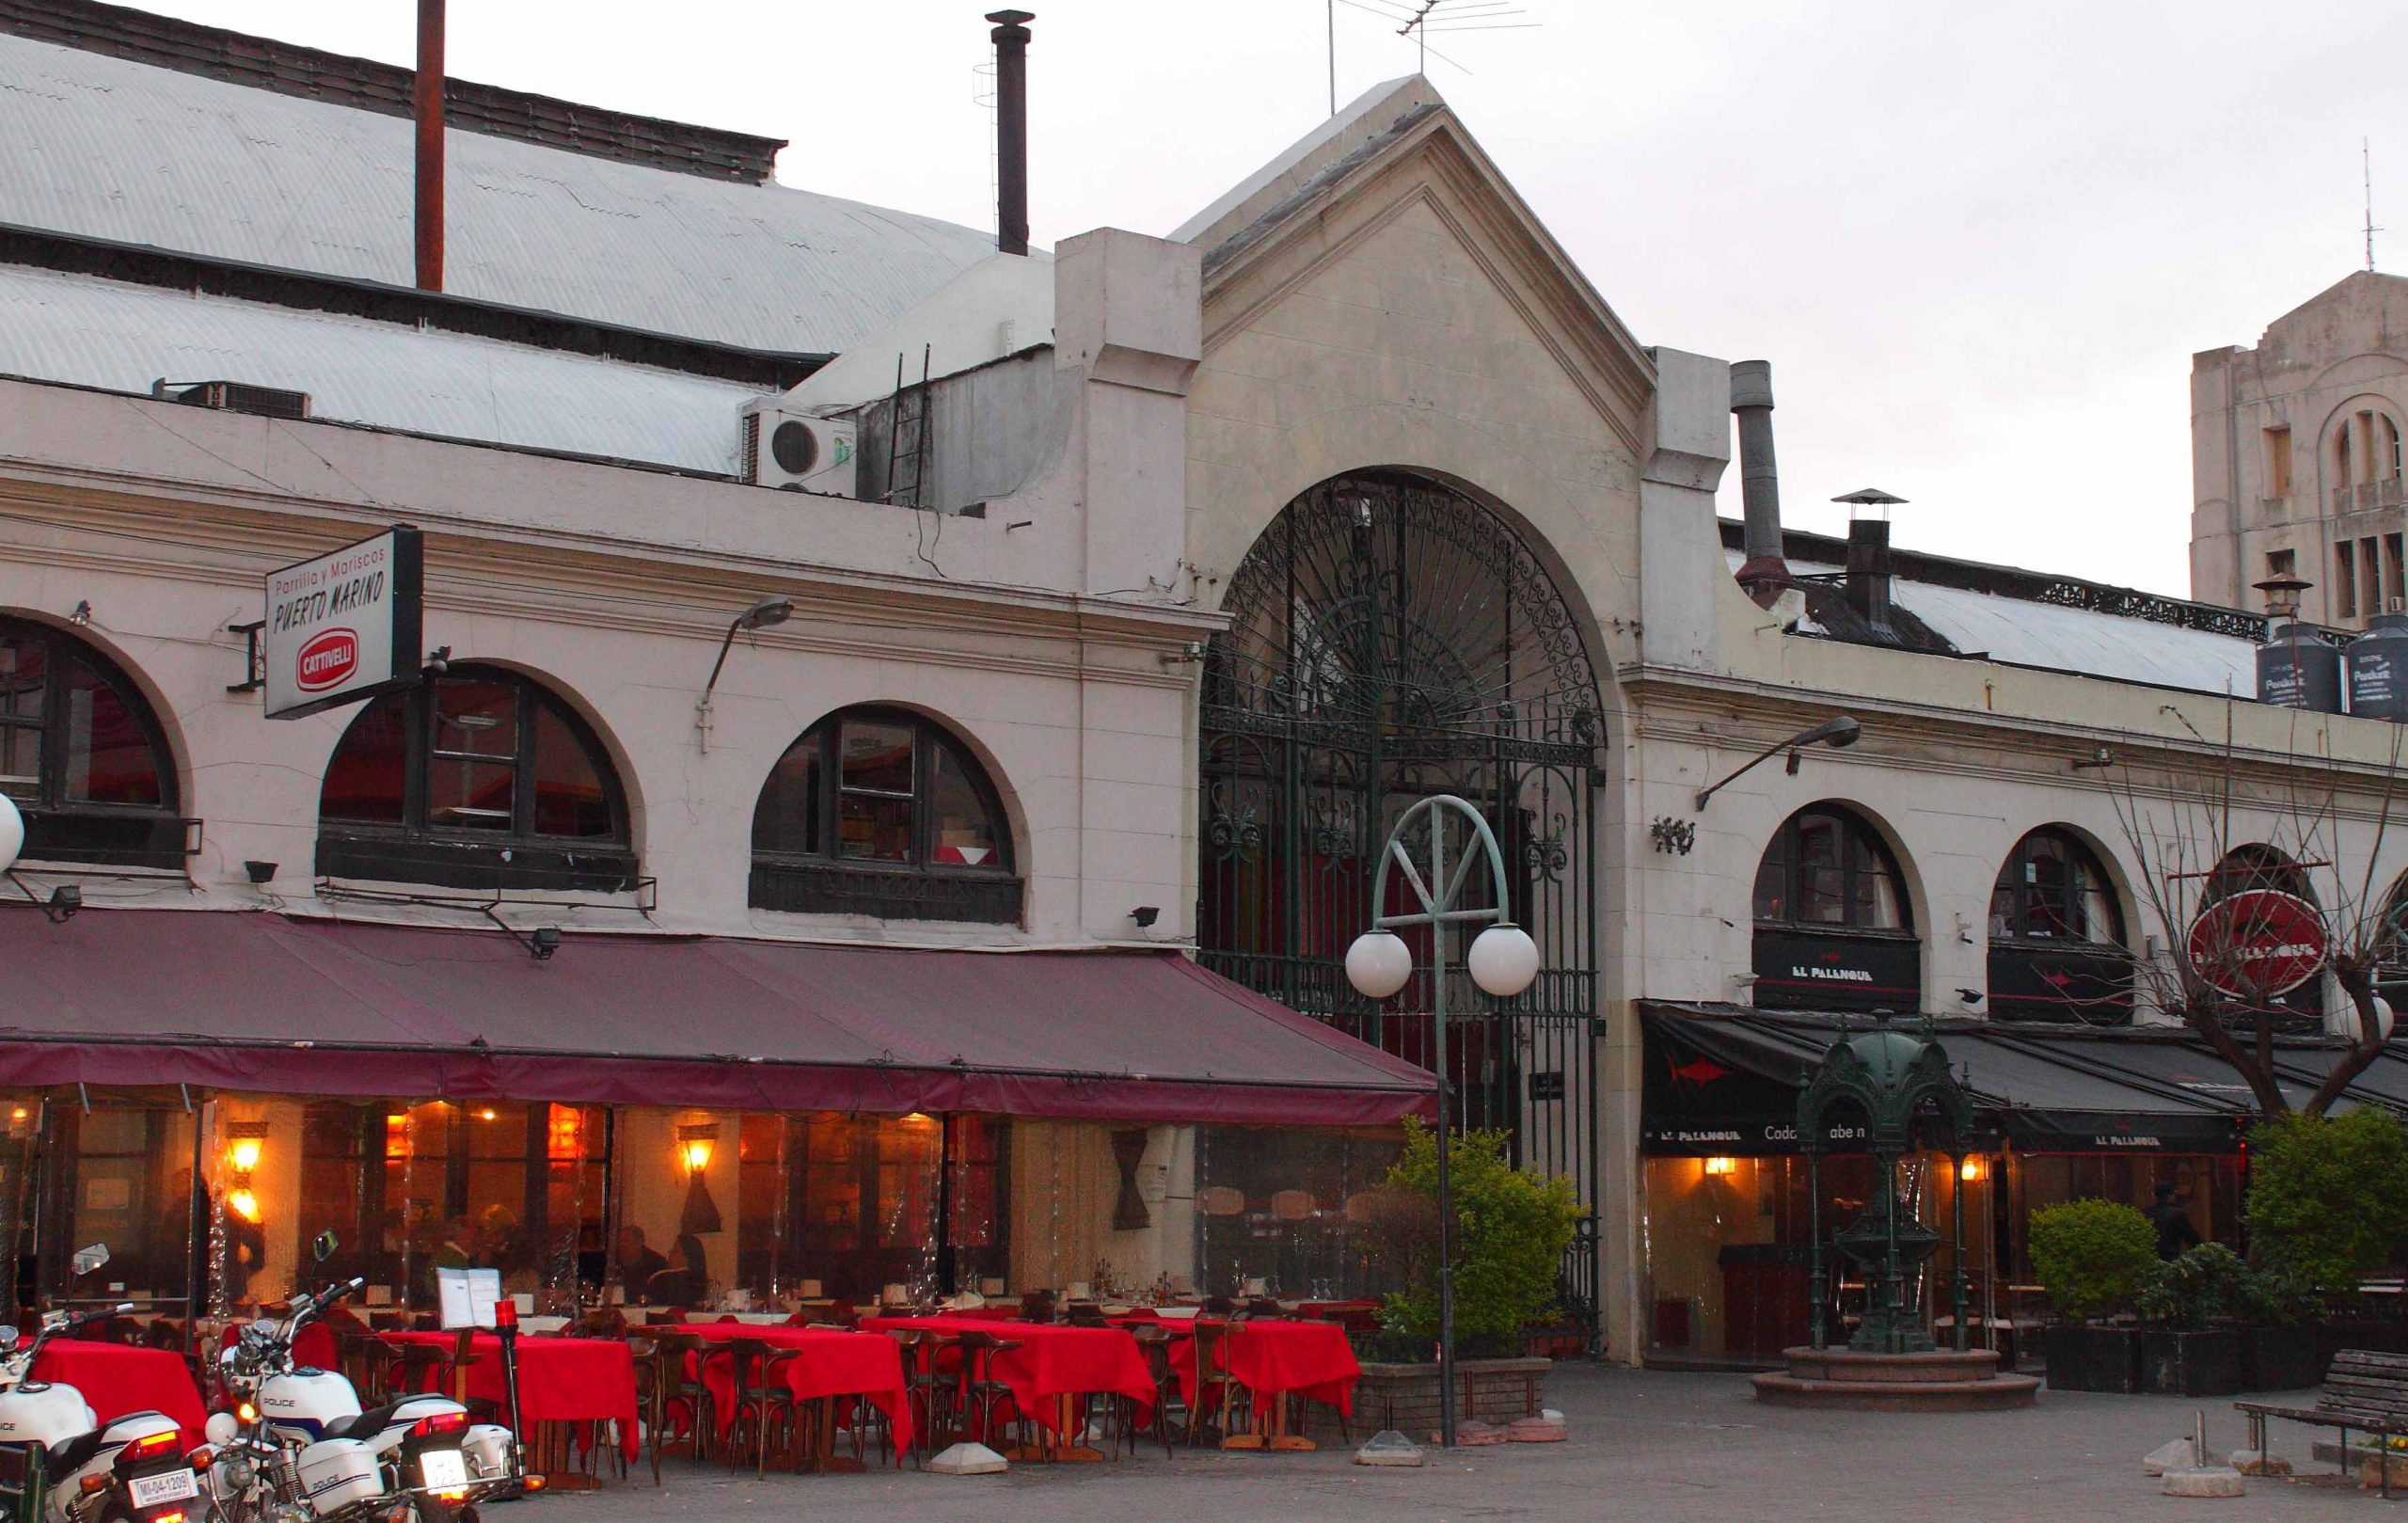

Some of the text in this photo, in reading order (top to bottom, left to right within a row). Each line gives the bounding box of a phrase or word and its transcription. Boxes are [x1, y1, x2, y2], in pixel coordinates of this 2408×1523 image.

[276, 548, 385, 596] Parrilla y Mariscos
[274, 571, 384, 634] PUERTO MARINO
[303, 643, 352, 675] CATTIVELLI
[1792, 966, 1873, 981] EL PALENQUE
[263, 1398, 296, 1407] POLICE
[0, 1421, 16, 1431] ICE
[313, 1474, 340, 1489] POLICE
